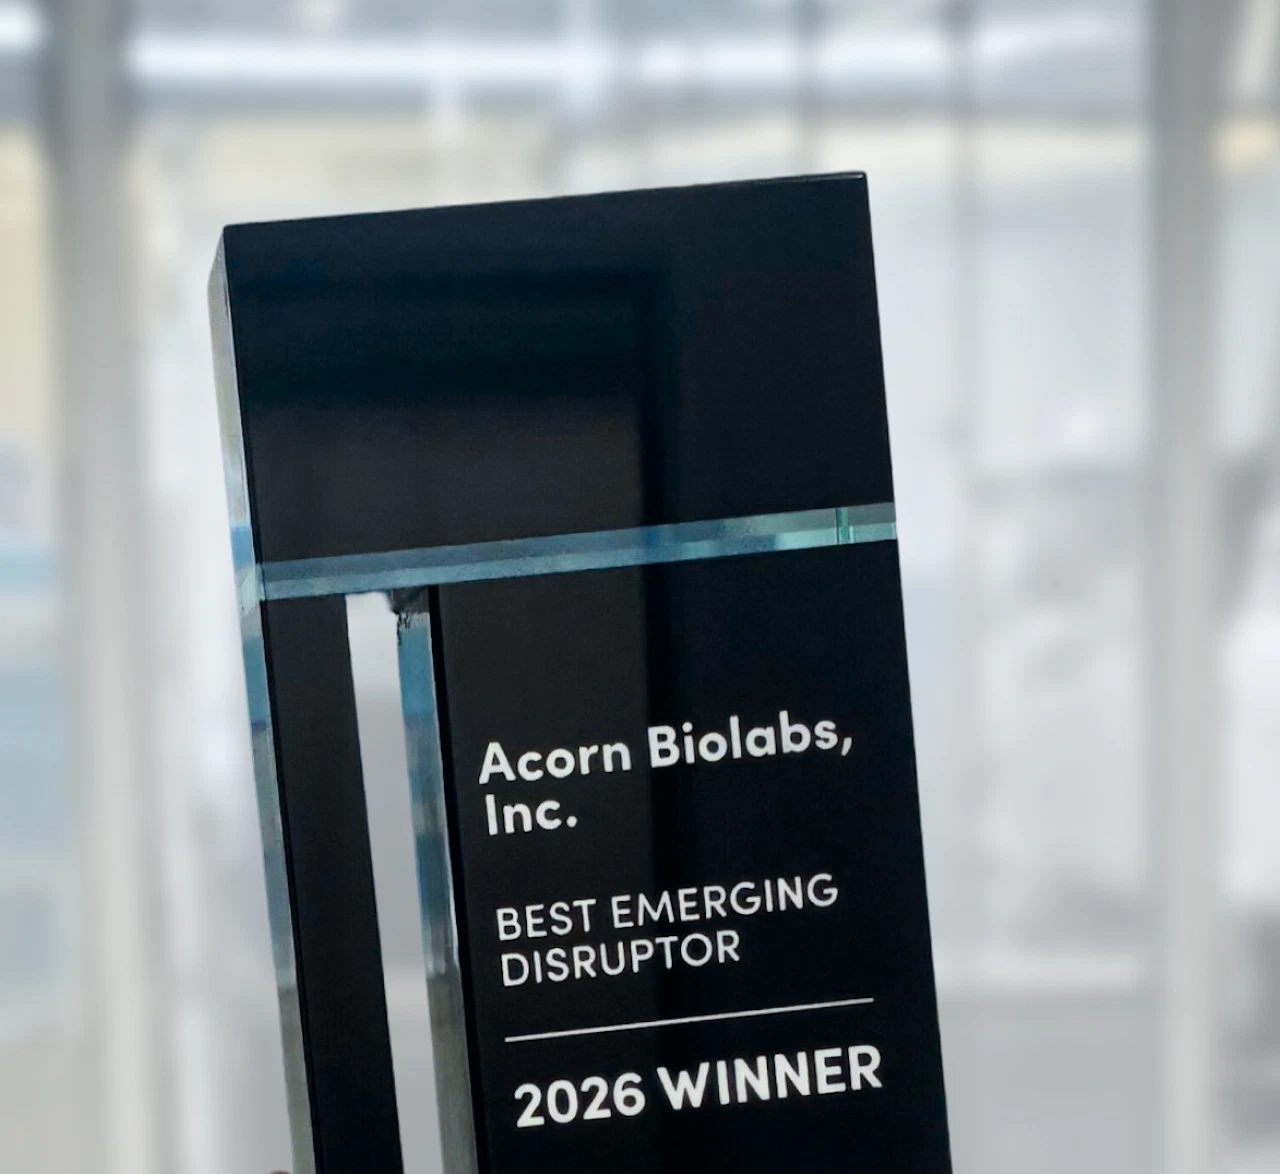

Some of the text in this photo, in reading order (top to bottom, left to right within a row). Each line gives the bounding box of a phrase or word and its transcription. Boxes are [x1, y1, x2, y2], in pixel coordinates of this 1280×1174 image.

[478, 710, 852, 785] Acorn Biolabs,
[485, 794, 578, 836] Inc.
[496, 873, 838, 941] BEST EMERGING
[501, 930, 740, 987] DISRUPTOR
[514, 1044, 883, 1128] 2026 WINNER
